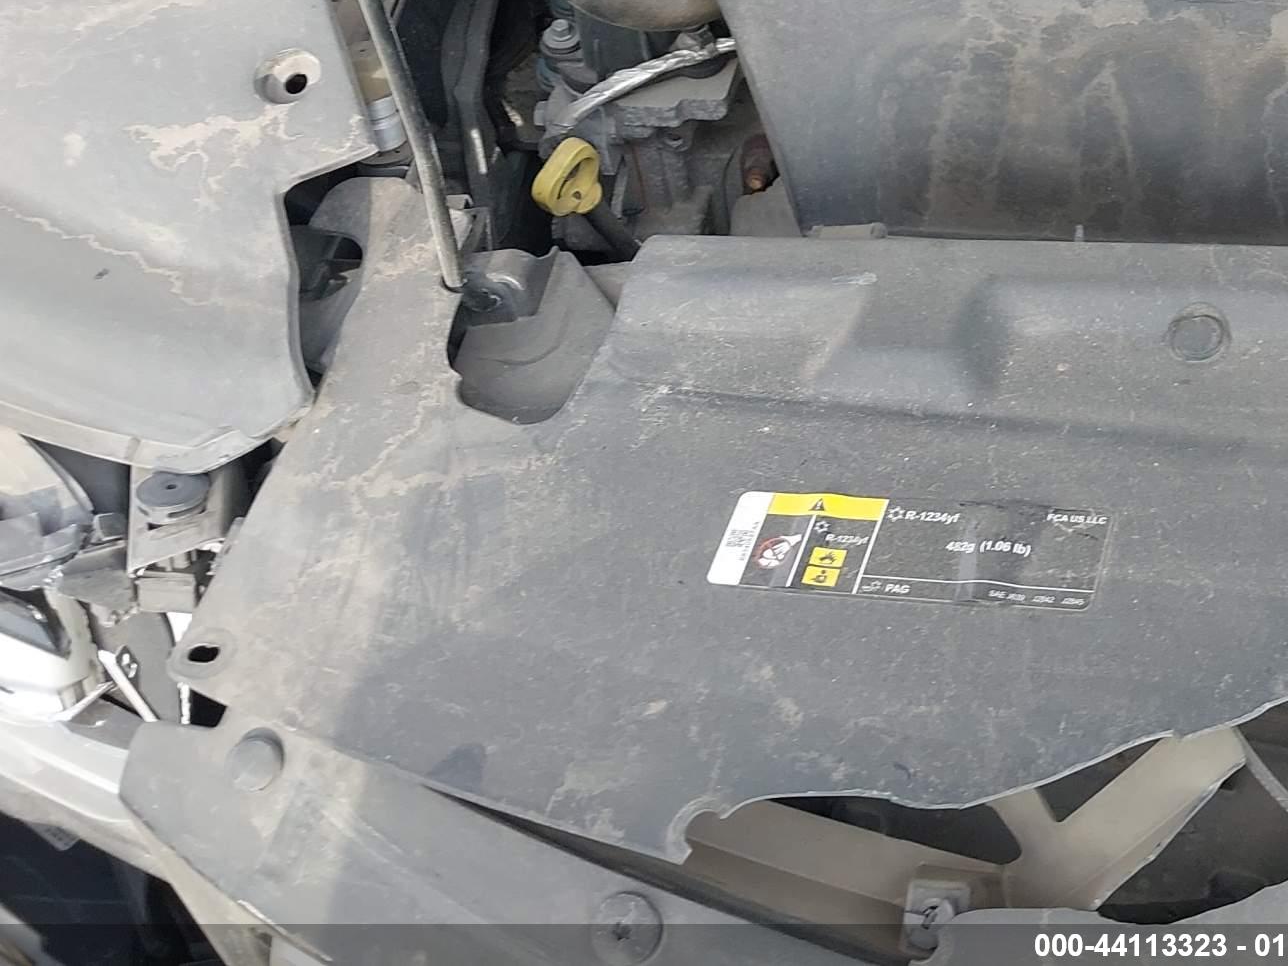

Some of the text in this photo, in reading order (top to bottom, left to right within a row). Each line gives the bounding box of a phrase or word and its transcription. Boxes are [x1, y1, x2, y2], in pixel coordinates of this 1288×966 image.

[904, 510, 962, 525] R-1234yf
[1046, 513, 1108, 525] FCA US LLC
[883, 582, 911, 595] PAG
